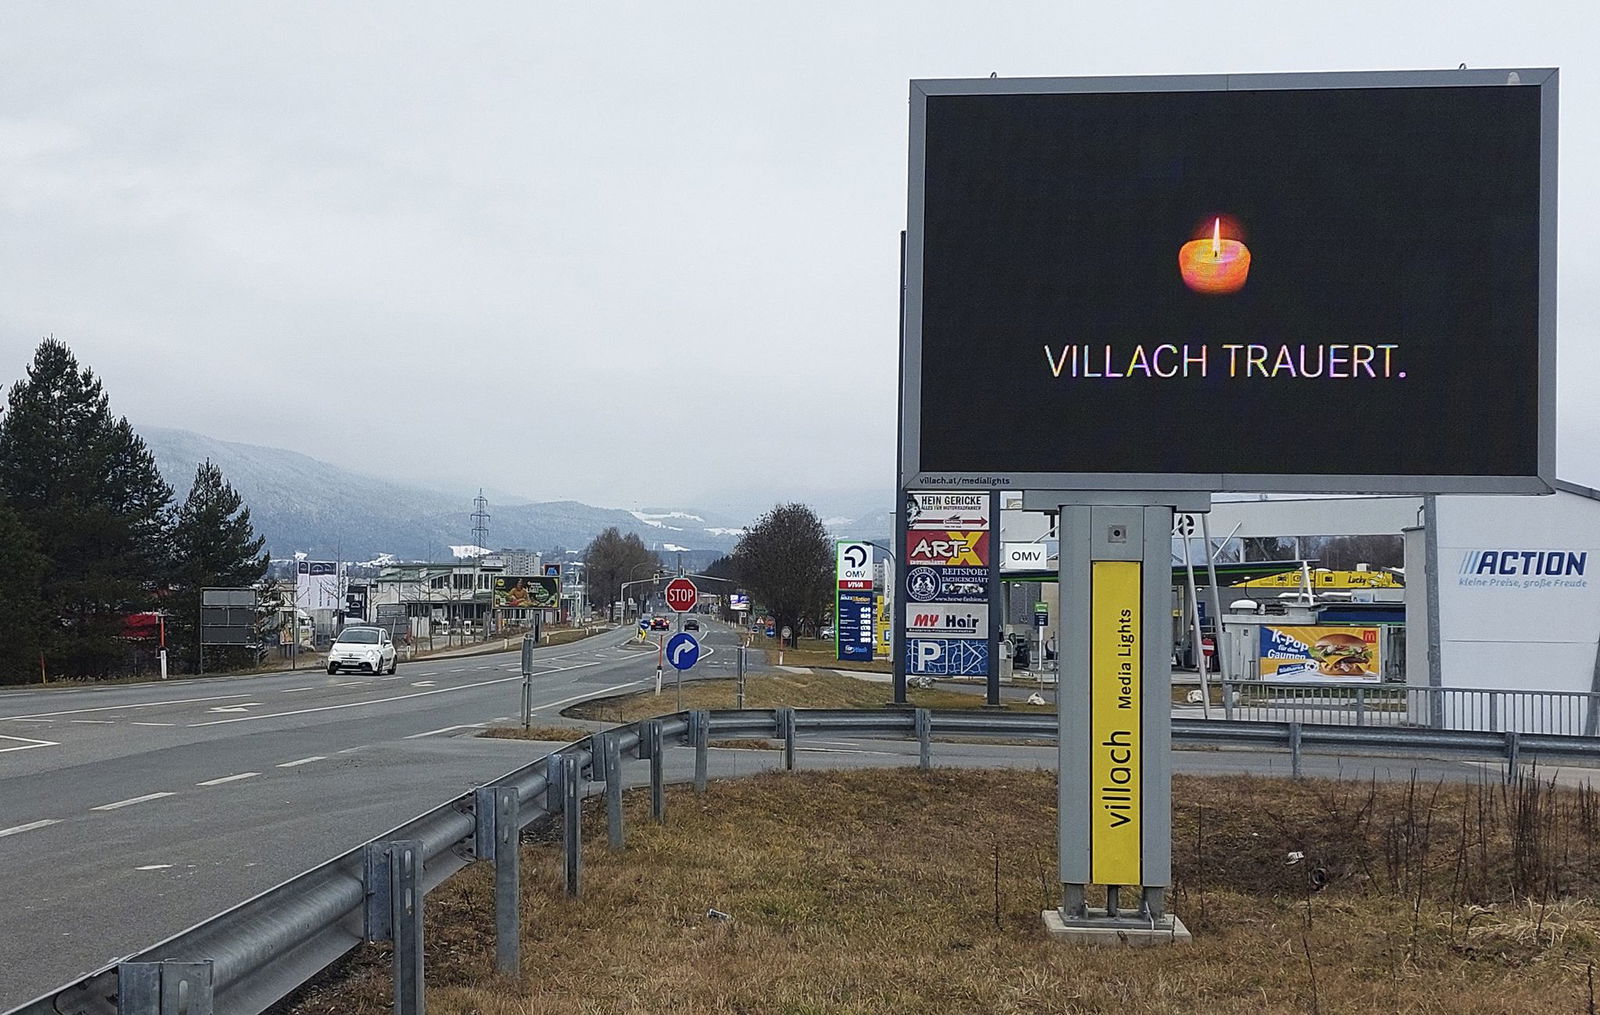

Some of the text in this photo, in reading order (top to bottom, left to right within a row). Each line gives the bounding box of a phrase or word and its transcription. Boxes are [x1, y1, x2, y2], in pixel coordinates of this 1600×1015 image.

[1044, 344, 1407, 378] VILLACH TRAUERT.
[919, 477, 1011, 486] villach.at/medialights
[921, 496, 982, 506] HEIN GERICKE
[1011, 551, 1041, 561] OMV
[1476, 551, 1587, 576] ACTION
[845, 570, 866, 578] OMV
[942, 568, 989, 576] REITSPORT
[1459, 578, 1489, 587] kleine
[1523, 579, 1552, 589] große
[1554, 579, 1588, 588] Freude
[669, 588, 694, 602] STOP
[913, 613, 980, 628] MY Hair
[1271, 628, 1309, 652] K-Pop
[918, 641, 941, 672] P
[1267, 648, 1306, 660] Gaumen
[1101, 608, 1135, 829] villach Media Lights
